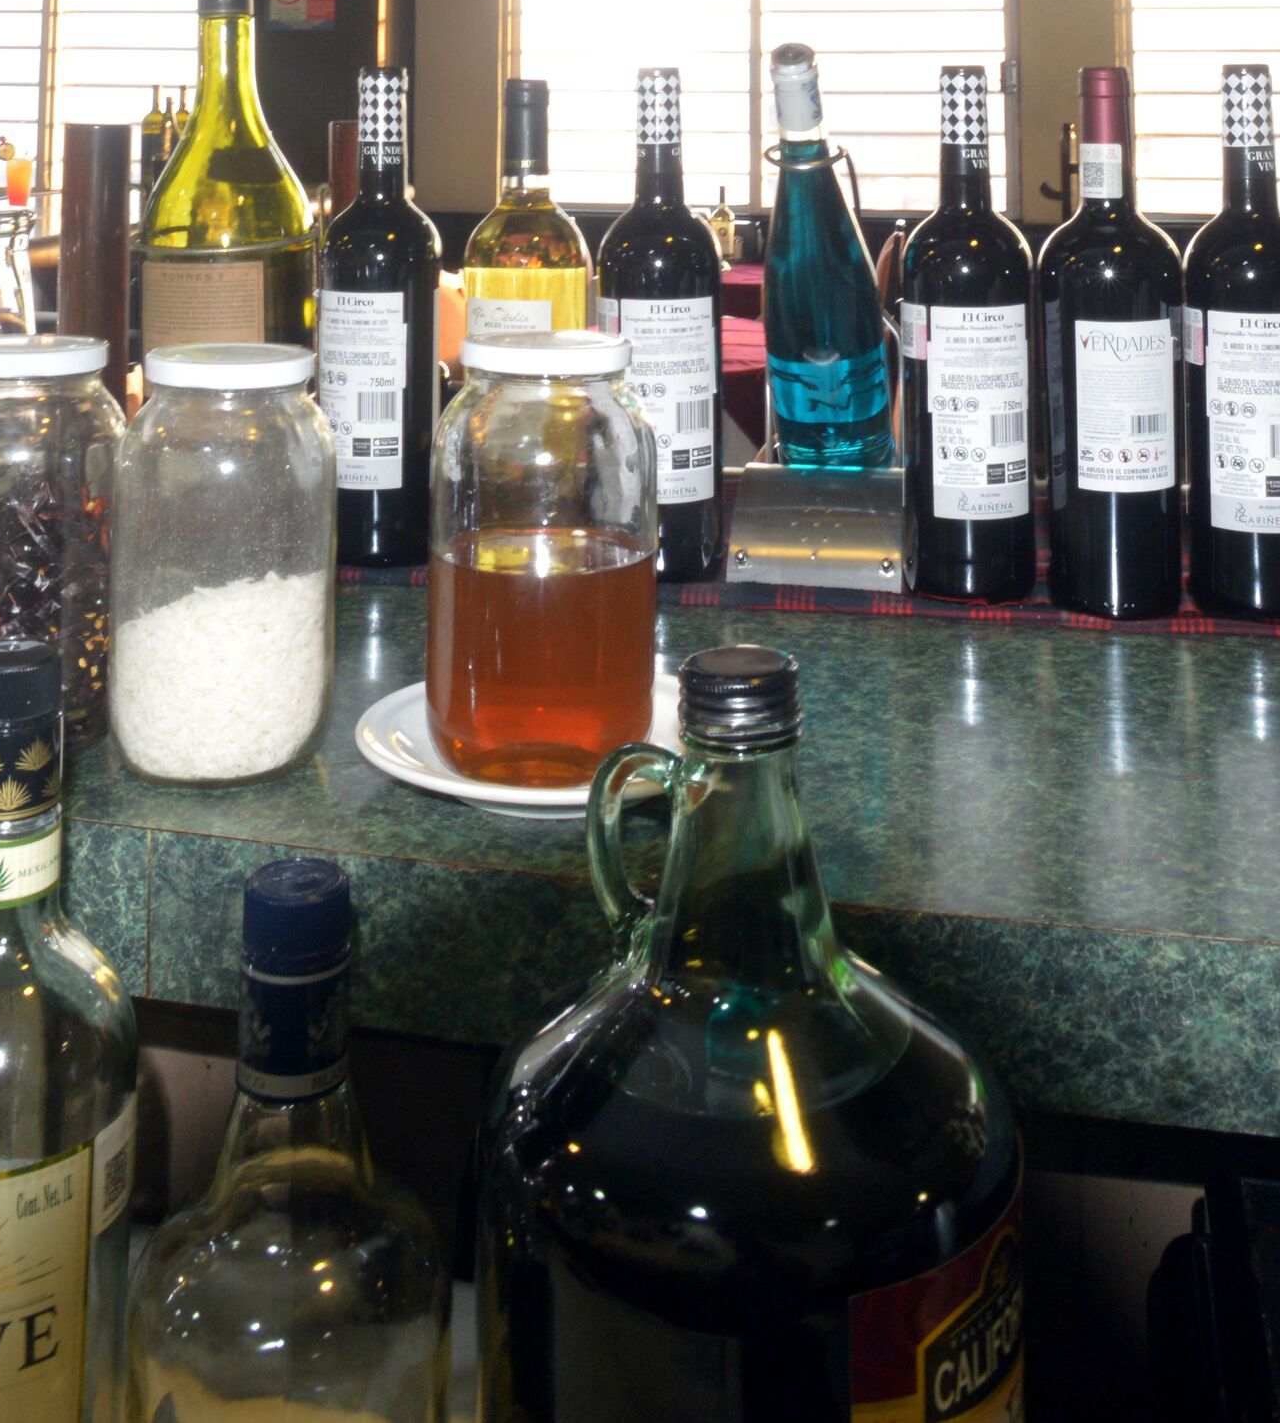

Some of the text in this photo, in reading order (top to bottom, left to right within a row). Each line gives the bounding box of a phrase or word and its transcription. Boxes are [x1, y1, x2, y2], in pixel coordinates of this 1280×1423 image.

[337, 297, 374, 306] El Circo
[650, 305, 690, 314] El Circo
[963, 313, 1004, 322] El Circo
[1240, 318, 1251, 328] El
[1080, 330, 1165, 362] VERDADES
[370, 378, 394, 387] 750ml
[689, 384, 709, 395] 750ml
[1003, 401, 1022, 410] 750ml
[338, 473, 379, 481] ARIÑENA
[657, 486, 697, 495] ARIÑENA
[934, 1291, 1020, 1412] CALIFO
